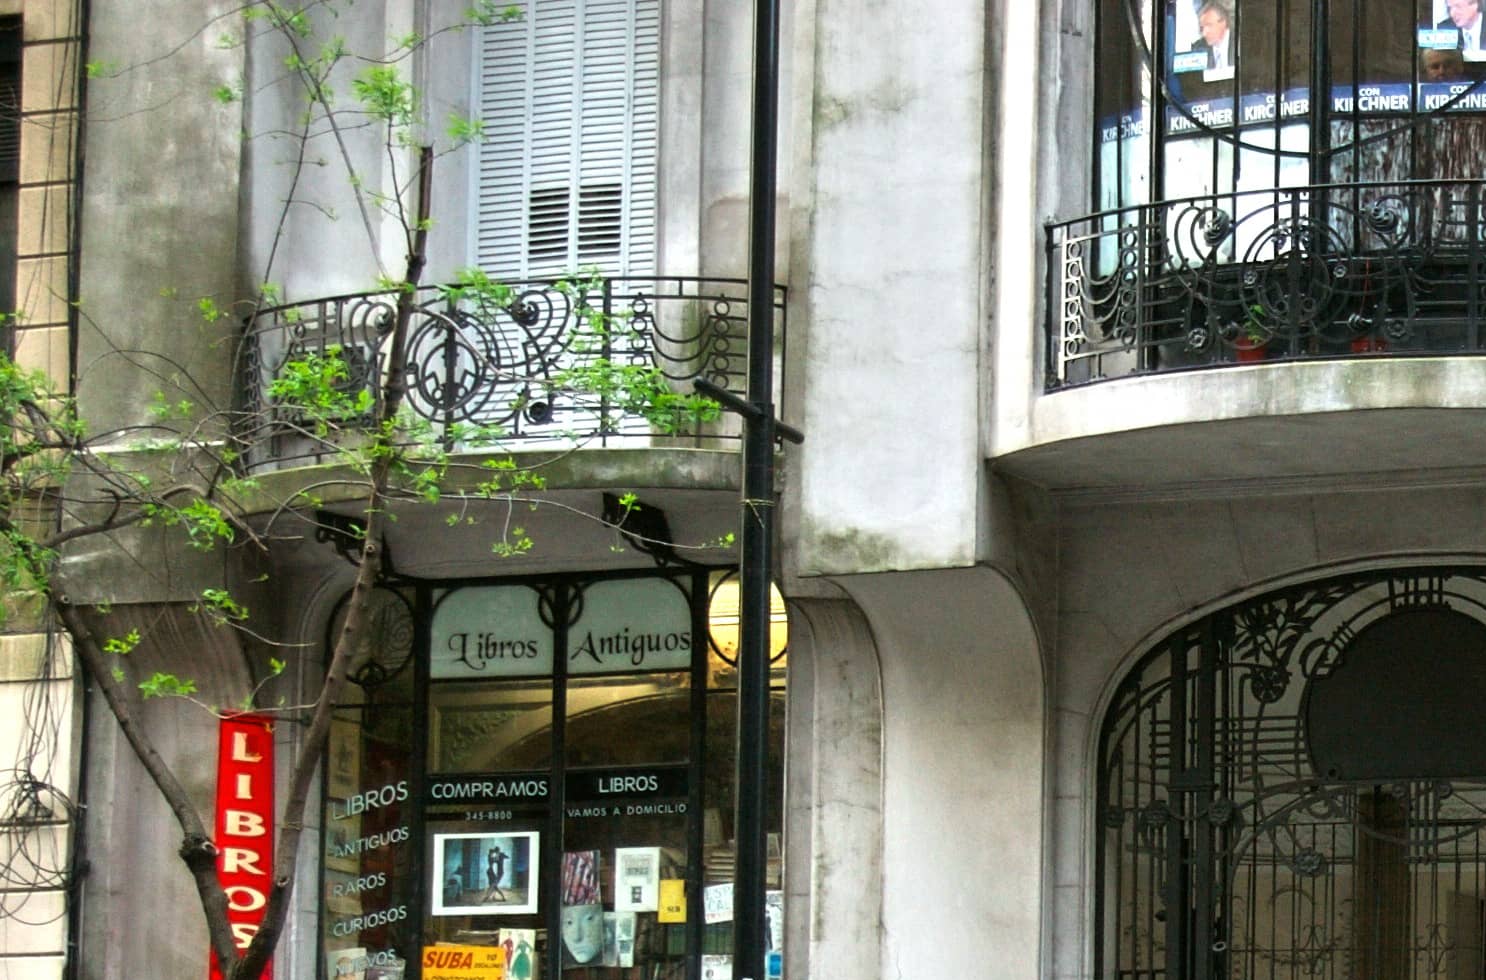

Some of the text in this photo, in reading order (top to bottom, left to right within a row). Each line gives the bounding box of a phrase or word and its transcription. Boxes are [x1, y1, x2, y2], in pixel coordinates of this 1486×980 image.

[1359, 87, 1381, 97] CON
[448, 627, 691, 671] Libros Antiguos
[431, 781, 548, 799] COMPRAMOS
[599, 776, 658, 793] LIBROS
[332, 781, 409, 820] LIBROS
[567, 803, 687, 818] VAMOS A DOMICILIO
[223, 731, 266, 949] LIBROS
[334, 826, 409, 858] ANTIGUOS
[333, 872, 386, 897] RAROS
[333, 905, 407, 937] CURIOSOS
[424, 951, 474, 969] SUBA
